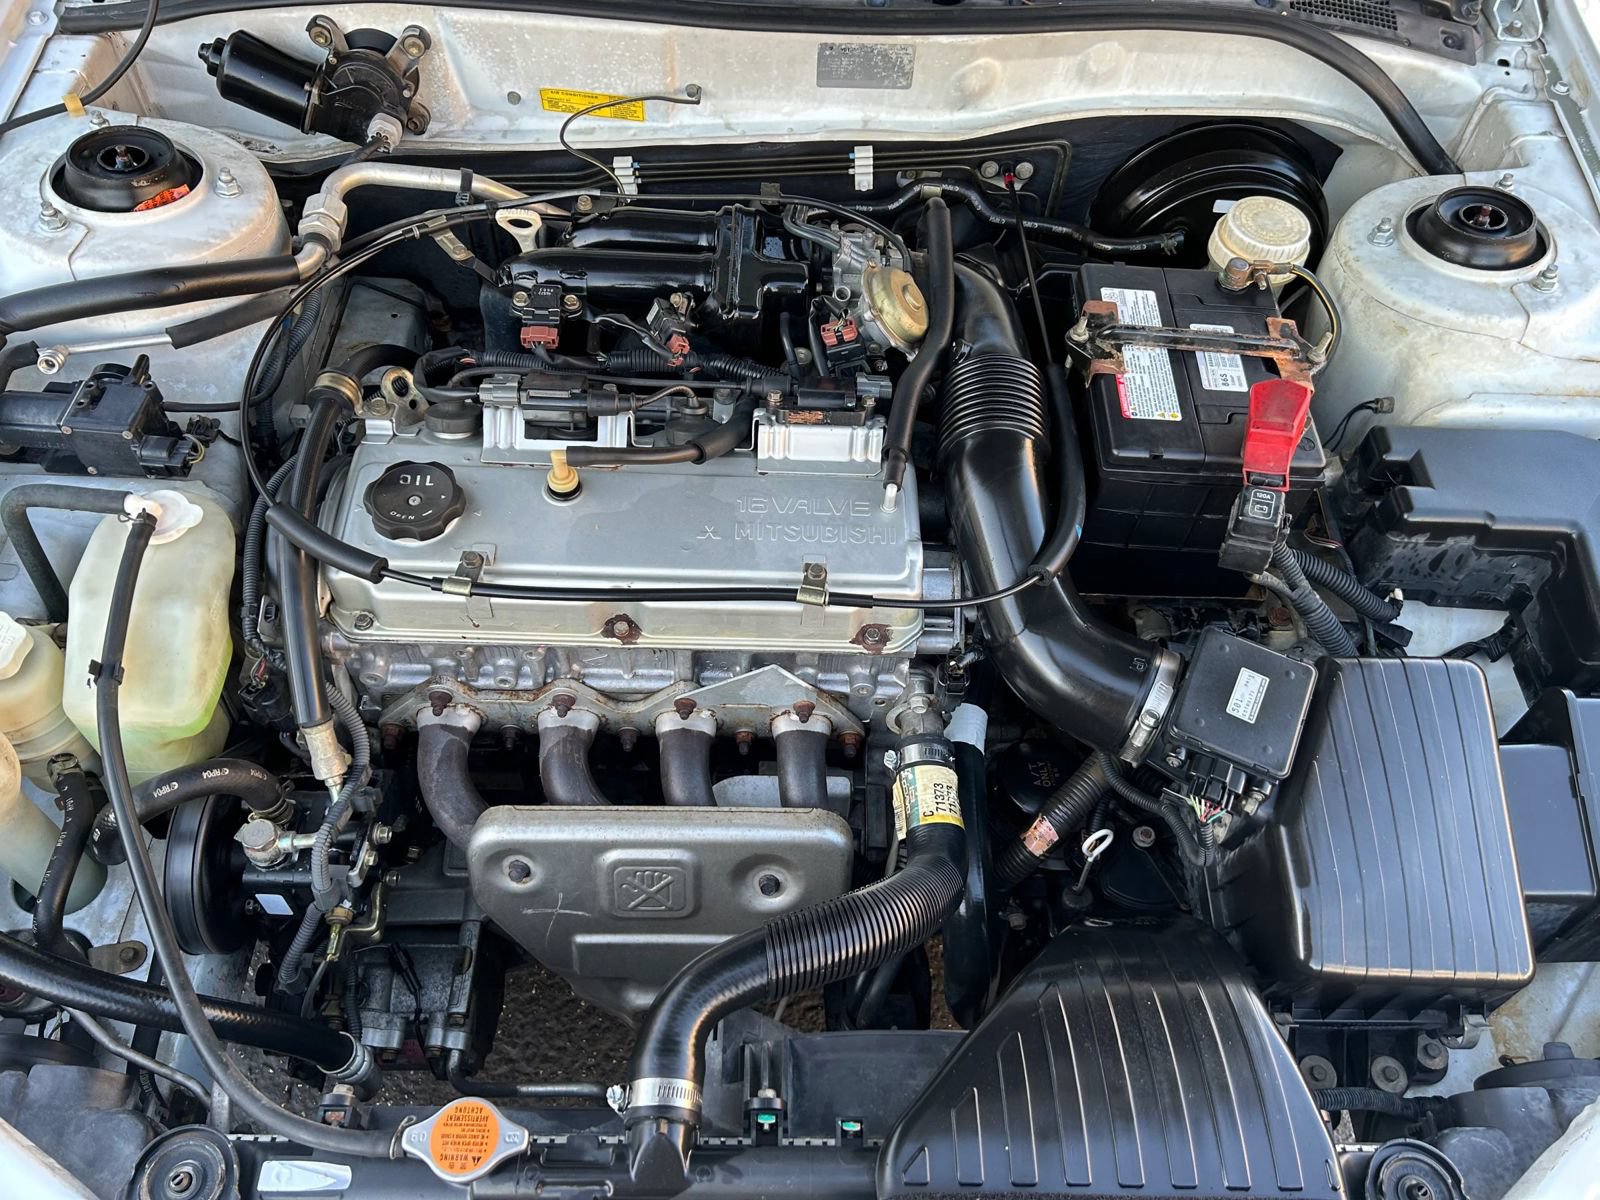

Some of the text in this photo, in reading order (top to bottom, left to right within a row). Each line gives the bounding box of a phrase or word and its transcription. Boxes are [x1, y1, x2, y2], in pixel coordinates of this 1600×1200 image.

[400, 474, 435, 486] OIL
[389, 510, 415, 520] OPEN
[735, 523, 897, 545] MITSUBISHI
[202, 770, 221, 779] RP04
[1037, 761, 1051, 787] ONLY
[153, 784, 171, 798] RP04
[933, 782, 947, 812] 71373
[454, 1106, 483, 1114] ACHTUNG
[446, 1114, 489, 1122] AVERTISSEMENT
[440, 1153, 469, 1161] WARNING
